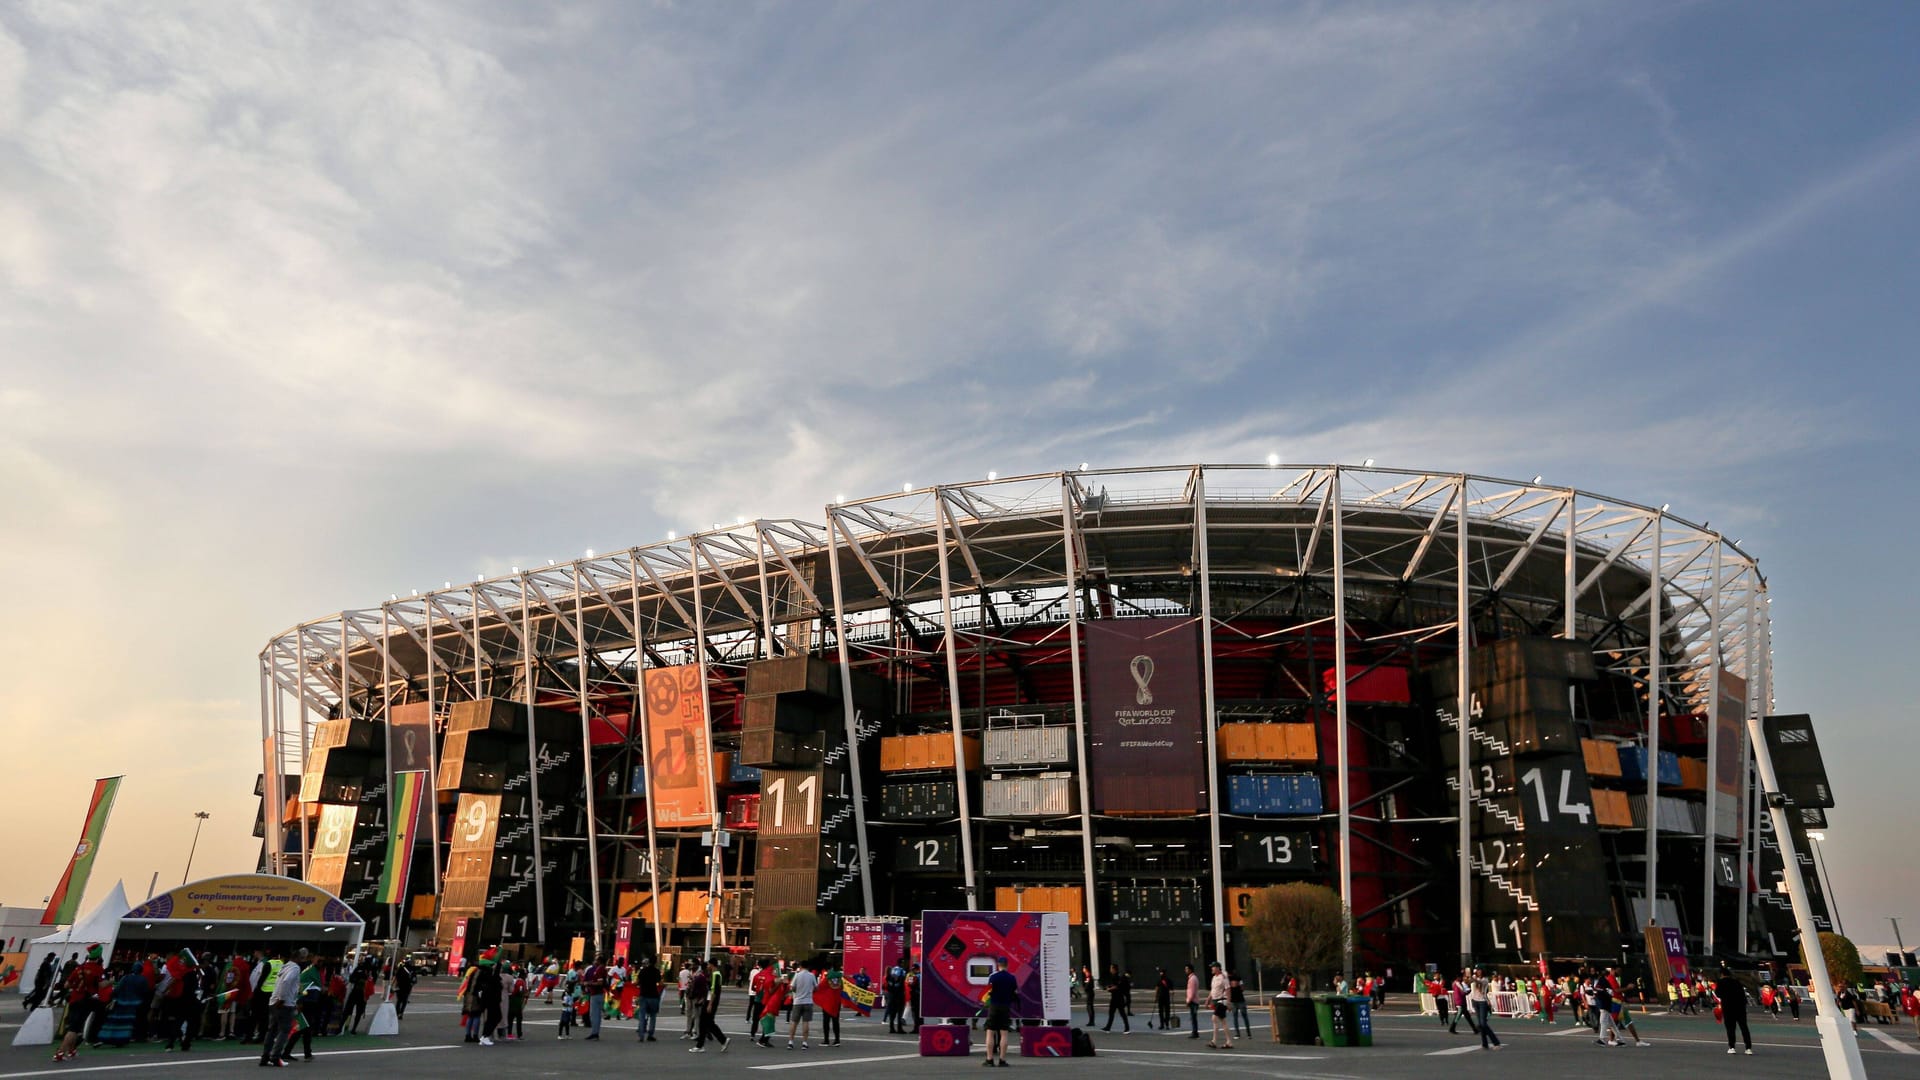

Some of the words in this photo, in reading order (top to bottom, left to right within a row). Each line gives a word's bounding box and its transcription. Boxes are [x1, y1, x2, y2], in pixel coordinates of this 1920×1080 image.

[767, 775, 816, 827] 11
[1521, 768, 1591, 824] 14
[323, 803, 343, 849] 8
[465, 801, 488, 842] 9
[837, 842, 859, 869] L2
[914, 839, 939, 866] 12
[1260, 835, 1292, 863] 13
[1479, 841, 1509, 871] L2
[511, 854, 537, 878] L2
[1720, 856, 1734, 882] 15
[188, 892, 263, 903] Complimentary
[265, 894, 290, 902] Team
[291, 895, 316, 904] Flags
[456, 926, 464, 936] 10
[501, 914, 528, 937] L1
[620, 926, 628, 939] 11
[1491, 920, 1522, 949] L1
[1667, 938, 1680, 952] 14
